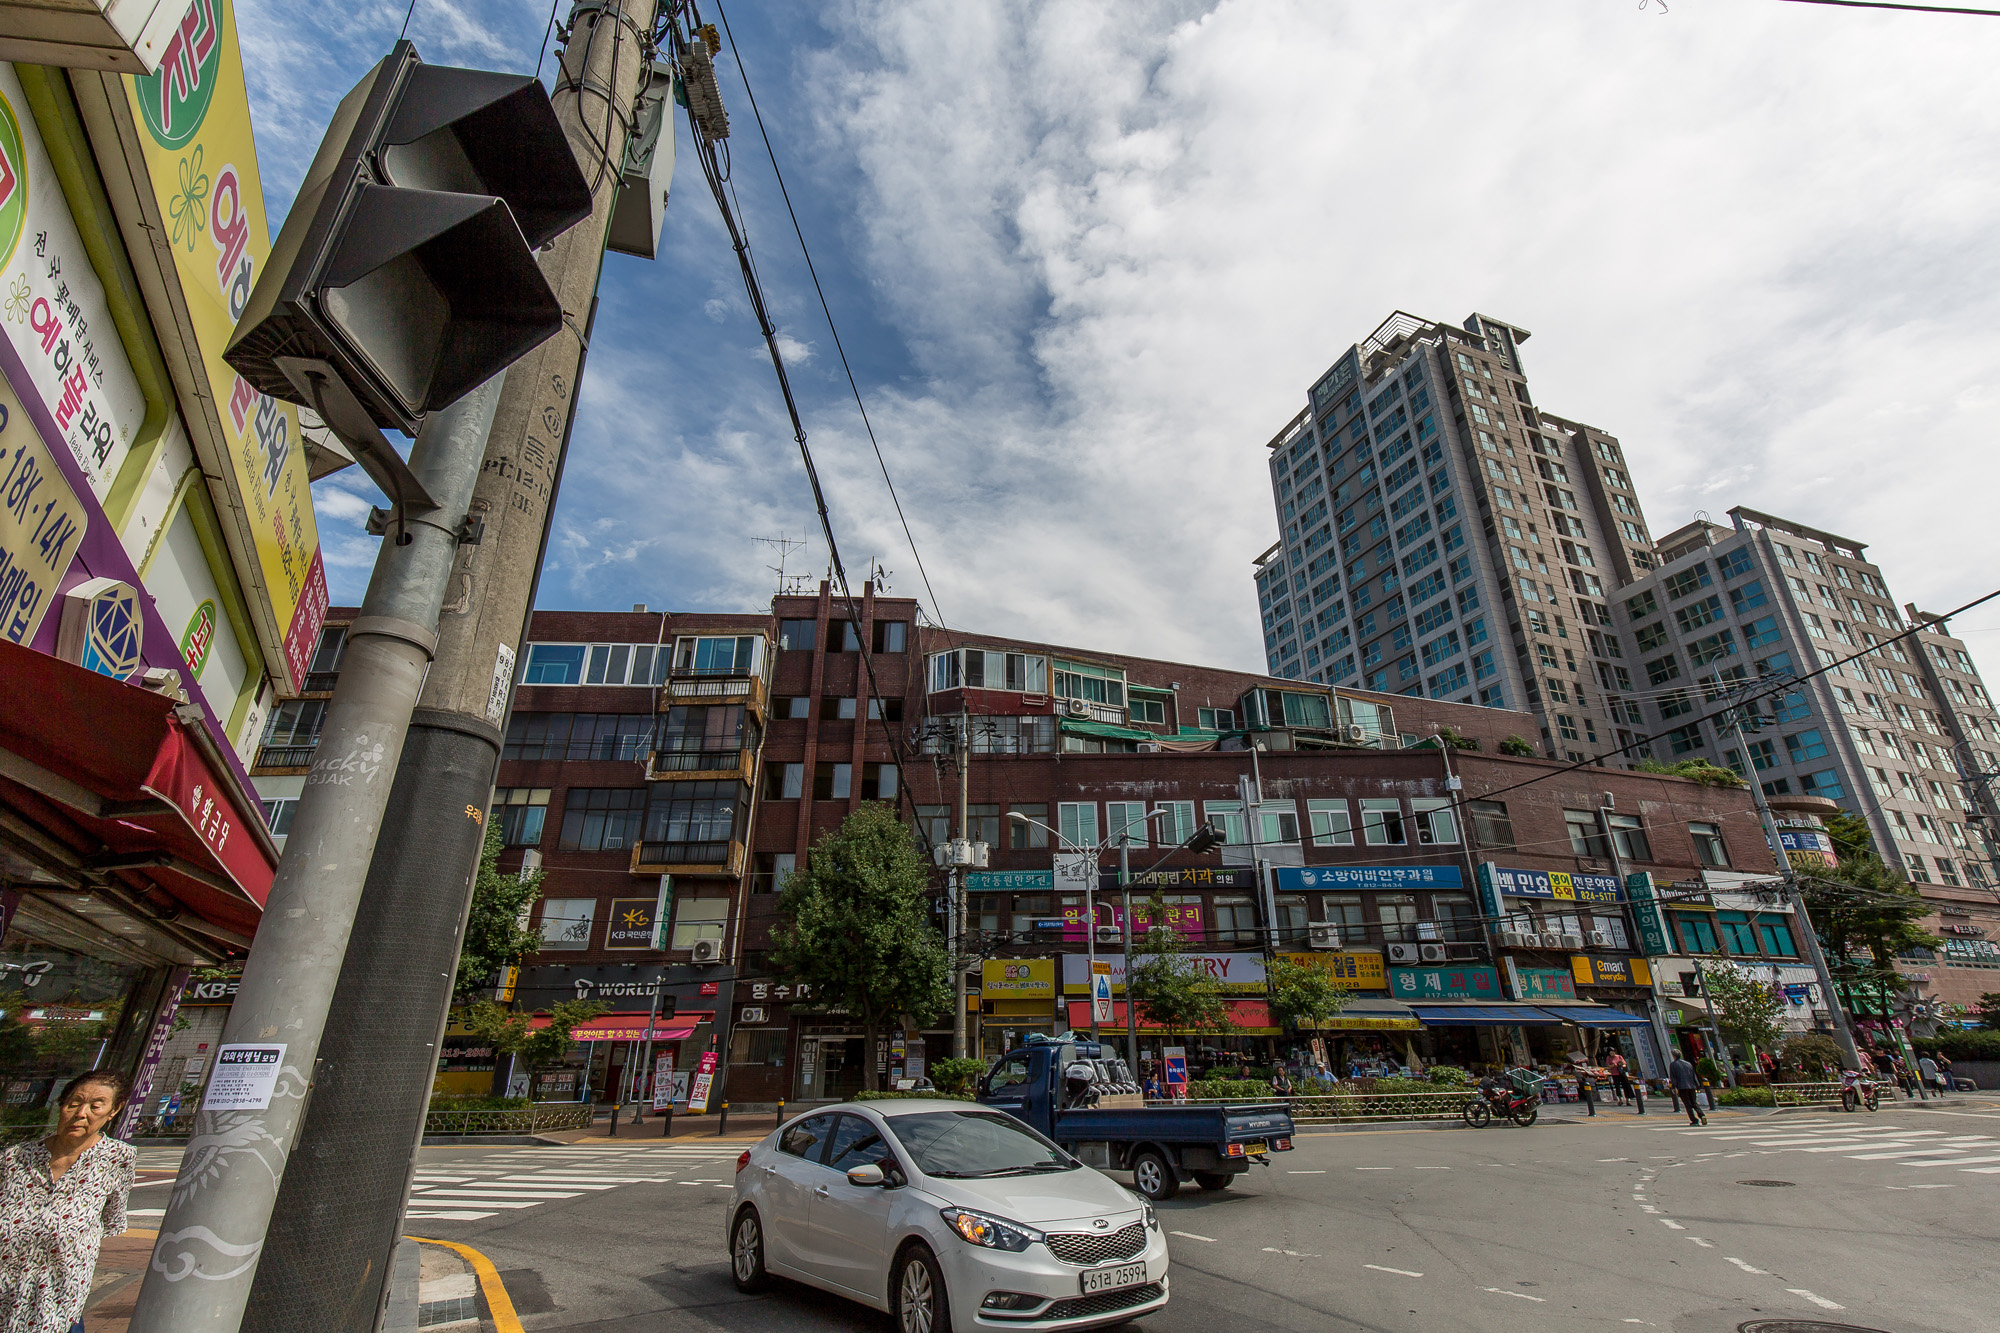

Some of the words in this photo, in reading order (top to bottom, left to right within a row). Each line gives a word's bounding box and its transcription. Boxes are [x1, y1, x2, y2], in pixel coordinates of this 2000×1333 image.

[54, 280, 88, 344] 꽃배달
[82, 338, 104, 390] 서비스
[30, 296, 115, 470] 예하플라워
[68, 430, 85, 462] Yeaha
[242, 433, 256, 482] Yeaha
[252, 479, 266, 525] Flower
[309, 750, 379, 784] ucky
[1182, 868, 1214, 884] 치과
[1216, 874, 1234, 884] 의원
[1322, 869, 1421, 882] 소망이비인후과
[1499, 872, 1552, 893] 배민효
[1550, 872, 1570, 886] 영어
[1573, 876, 1617, 892] 전문학원
[1555, 886, 1574, 898] 수학
[1581, 890, 1617, 901] 824-5177
[612, 930, 626, 939] KB
[1597, 958, 1625, 973] emart
[1399, 972, 1491, 991] 형제과일
[1599, 972, 1627, 983] everyday
[599, 982, 657, 996] WORLD
[575, 1029, 605, 1039] 무엇이든
[606, 1030, 616, 1038] 할
[616, 1030, 624, 1038] 수
[625, 1029, 640, 1039] 있는
[222, 1051, 262, 1063] 과외선생님
[1094, 1219, 1108, 1229] KIA
[1089, 1271, 1112, 1291] 61러
[1116, 1264, 1141, 1285] 2599
